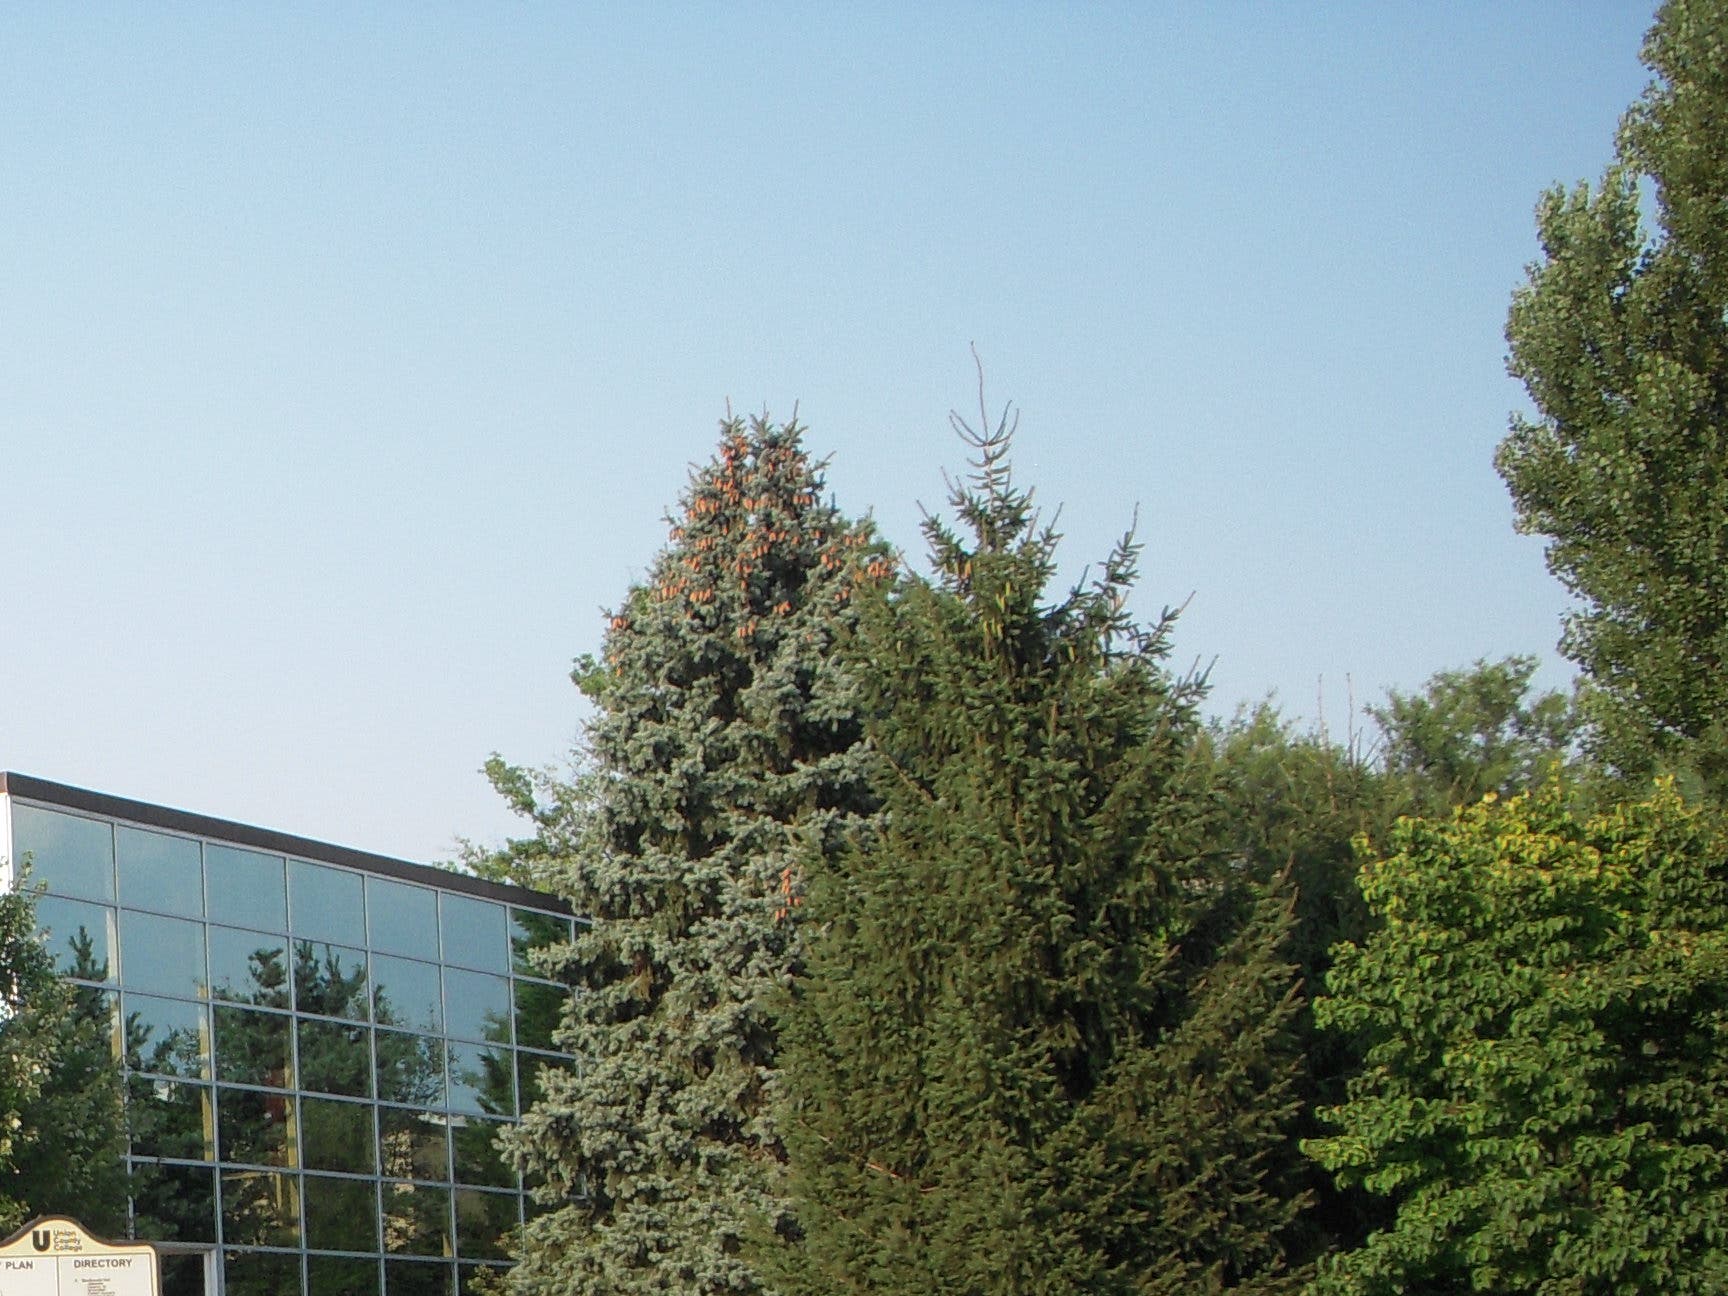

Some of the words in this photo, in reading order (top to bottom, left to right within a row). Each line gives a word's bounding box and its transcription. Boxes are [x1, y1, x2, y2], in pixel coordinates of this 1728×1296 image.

[53, 1229, 77, 1237] Union
[32, 1230, 51, 1252] U
[53, 1237, 81, 1245] County
[53, 1244, 83, 1252] College
[5, 1260, 34, 1270] PLAN
[74, 1258, 133, 1269] DIRECTORY
